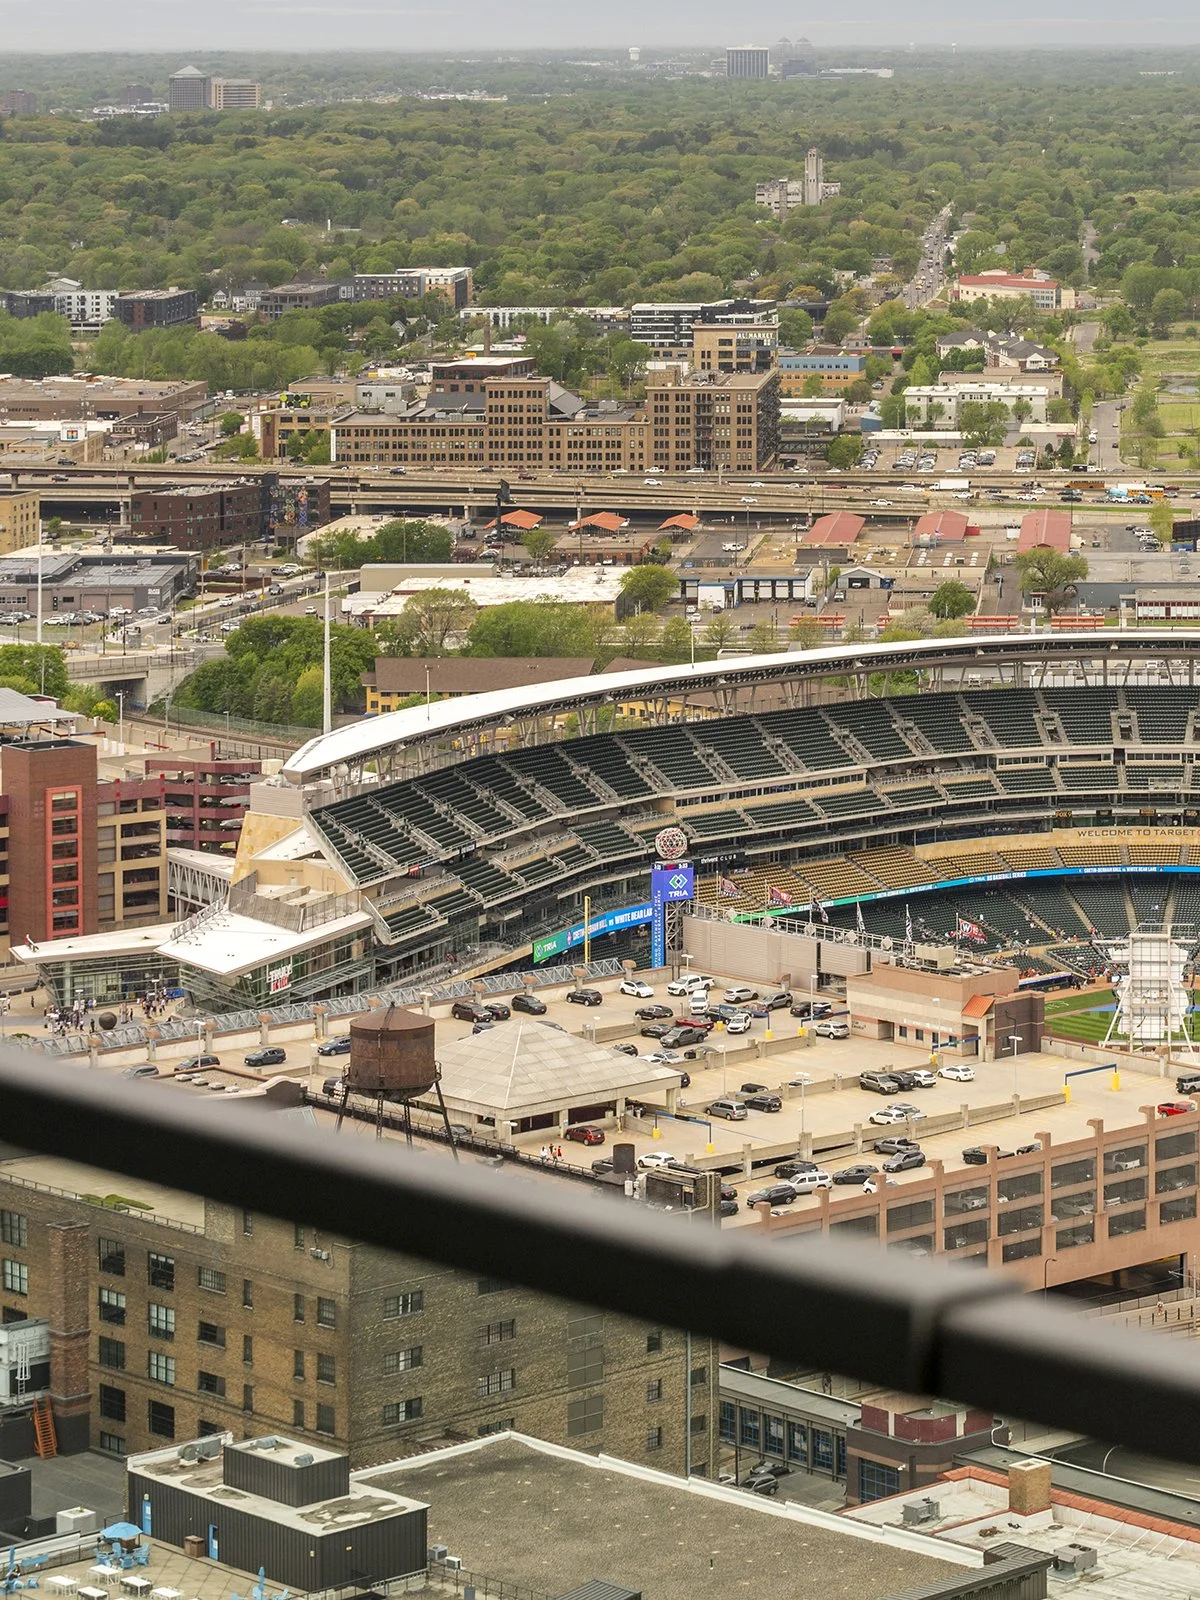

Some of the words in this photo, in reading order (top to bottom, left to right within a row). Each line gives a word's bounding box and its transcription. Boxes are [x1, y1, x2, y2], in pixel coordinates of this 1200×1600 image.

[1077, 829, 1133, 837] WELCOME
[615, 912, 630, 924] WHITE
[631, 909, 643, 920] BEAR
[543, 941, 557, 952] TRIA
